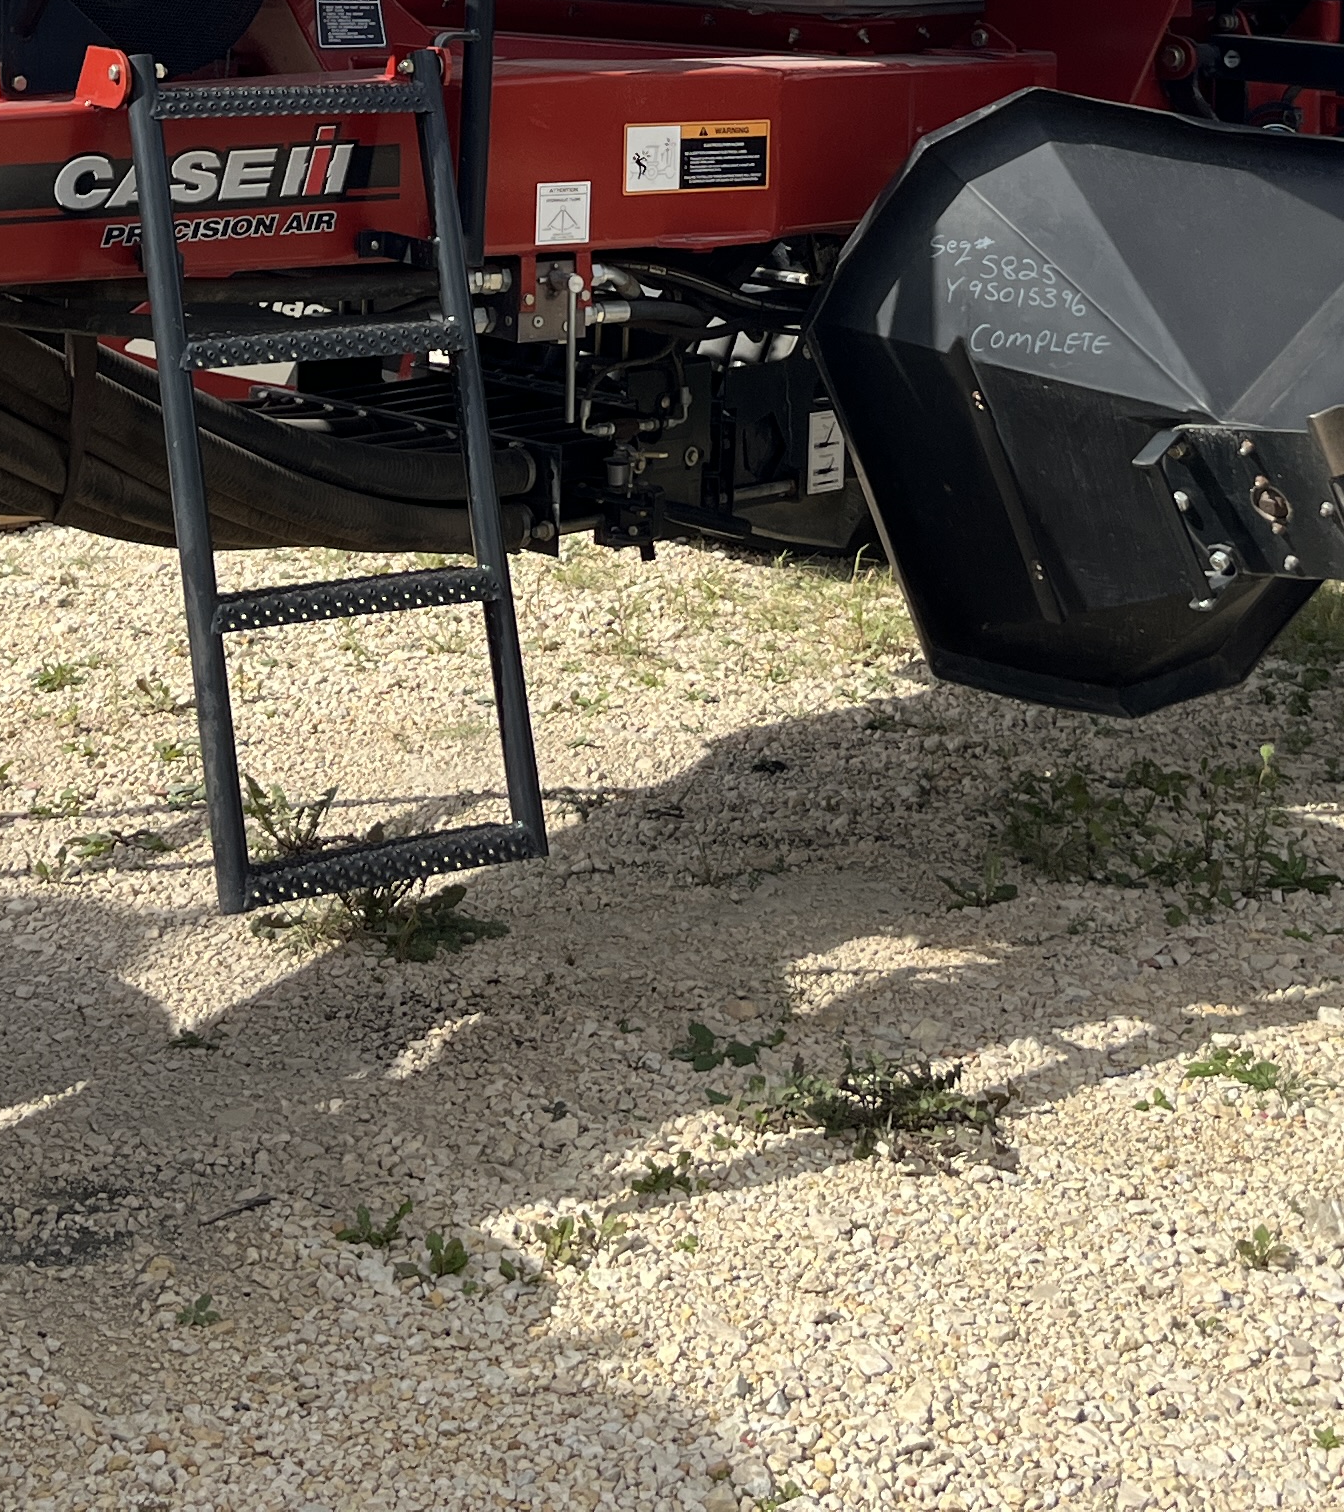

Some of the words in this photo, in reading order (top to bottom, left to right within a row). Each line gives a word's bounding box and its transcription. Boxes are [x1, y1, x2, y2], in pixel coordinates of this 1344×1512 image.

[101, 213, 278, 249] PRCISION
[280, 210, 338, 235] AIR
[979, 254, 1059, 286] 5825
